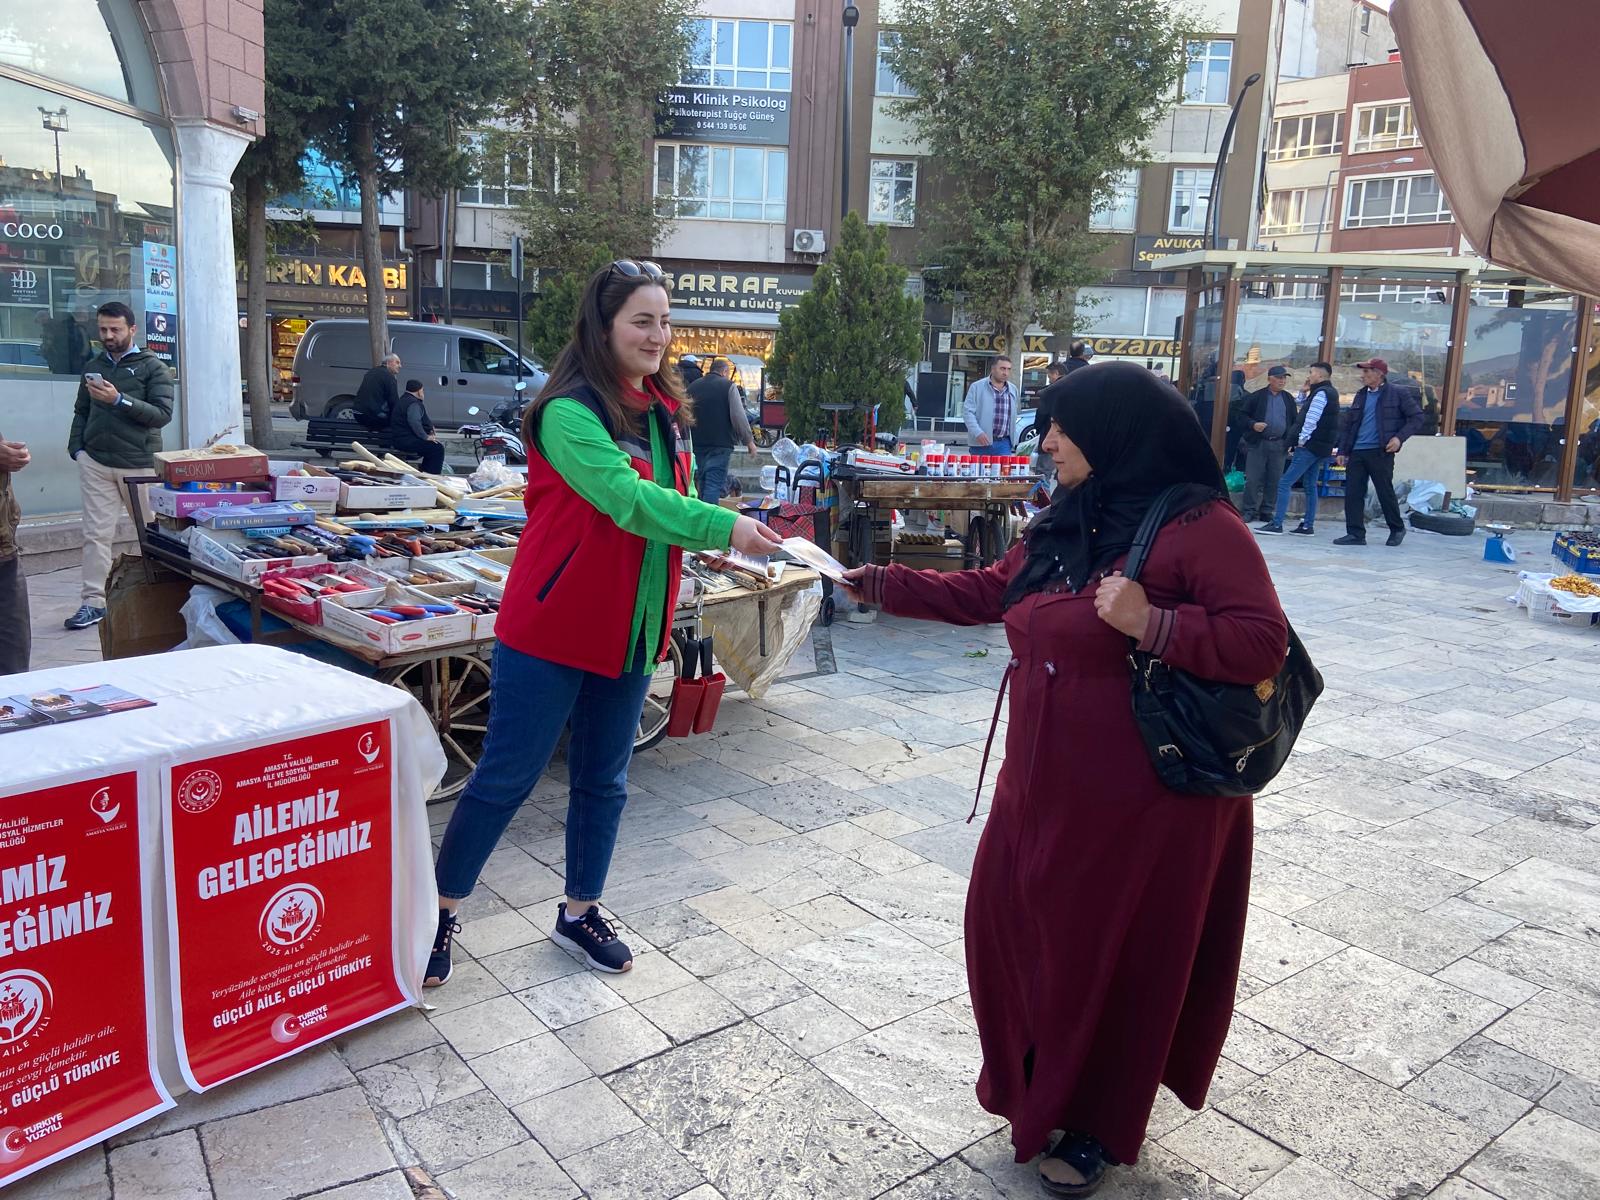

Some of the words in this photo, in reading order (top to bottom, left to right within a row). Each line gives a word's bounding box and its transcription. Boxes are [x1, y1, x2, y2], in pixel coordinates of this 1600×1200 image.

[693, 93, 728, 106] Klinik
[732, 95, 787, 111] Psikolog
[702, 121, 714, 129] 544
[723, 110, 747, 121] Tuğçe
[749, 112, 775, 122] Güneş
[3, 222, 63, 239] COCO
[1153, 238, 1209, 249] AVUKA
[328, 263, 406, 290] KABİ
[689, 296, 720, 307] ALTIN
[184, 462, 216, 477] LOKUM
[264, 762, 289, 773] AMASYA
[290, 755, 313, 768] VALİLİĞİ
[283, 753, 294, 761] T.C.
[236, 776, 261, 788] AMASYA
[262, 772, 276, 782] AİLE
[277, 769, 285, 778] VE
[285, 765, 307, 777] SOSYAL
[274, 772, 311, 787] MÜDÜRLÜĞÜ
[22, 818, 64, 834] HİZMETLER
[233, 788, 340, 846] AİLEMİZ
[198, 821, 372, 900] GELECEĞİMİZ
[262, 941, 281, 956] 2025
[211, 976, 258, 1000] Yeryüzünde
[259, 963, 293, 981] sevginin
[294, 959, 305, 967] en
[305, 949, 328, 966] güçlü
[329, 940, 354, 955] halidir
[212, 1000, 254, 1028] GÜÇLÜ
[256, 991, 286, 1012] AİLE,
[288, 971, 326, 997] GÜÇLÜ
[327, 955, 372, 982] TÜRKİYE
[238, 988, 256, 1001] Aile
[257, 975, 291, 993] koşulsuz
[292, 965, 313, 978] sevgi
[32, 1016, 51, 1038] YILI
[18, 1060, 30, 1071] en
[33, 1046, 61, 1068] güçlü
[63, 1033, 95, 1053] halidir
[16, 1066, 42, 1081] sevgi
[45, 1050, 88, 1073] demektir.
[11, 1073, 60, 1108] GÜÇLÜ
[63, 1050, 121, 1085] TÜRKİYE
